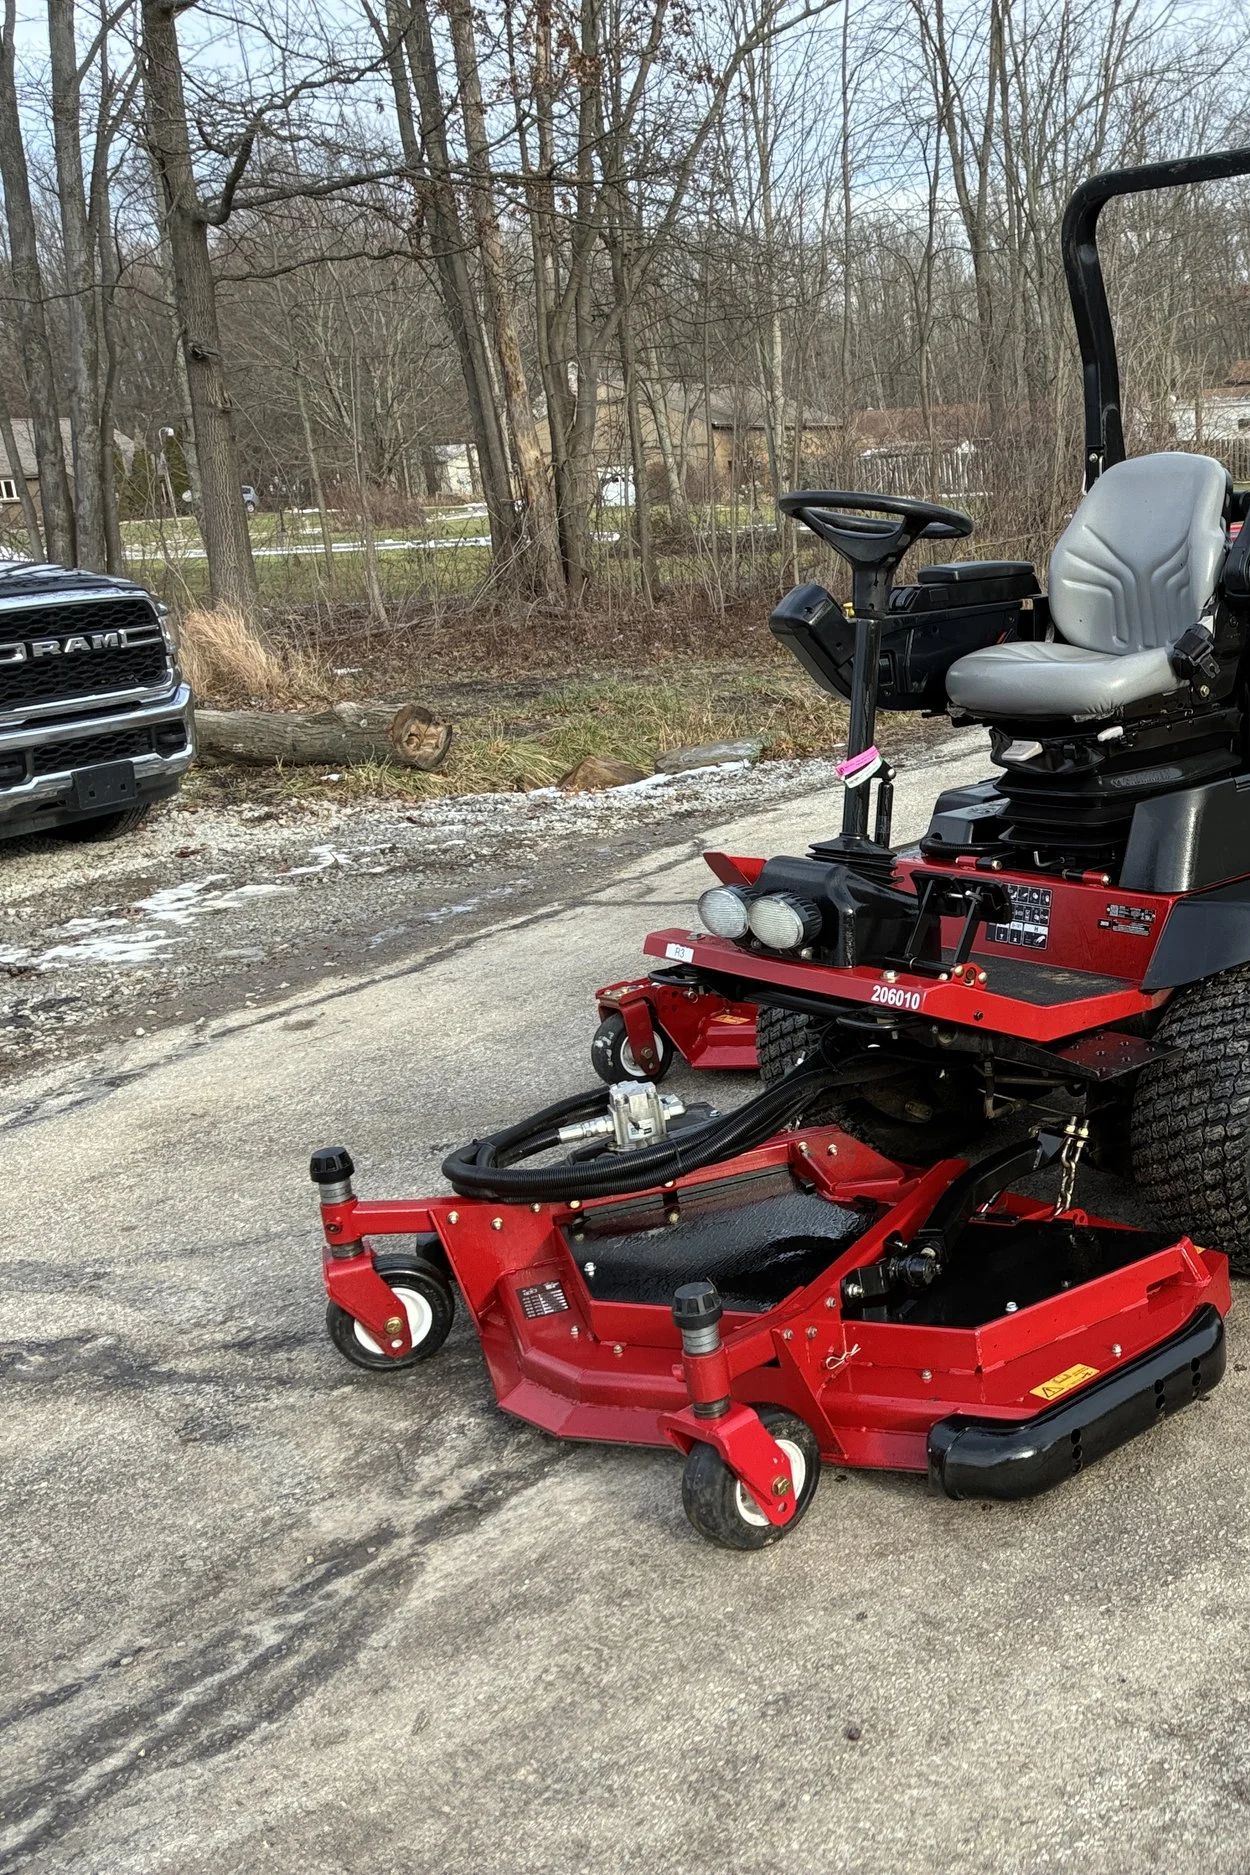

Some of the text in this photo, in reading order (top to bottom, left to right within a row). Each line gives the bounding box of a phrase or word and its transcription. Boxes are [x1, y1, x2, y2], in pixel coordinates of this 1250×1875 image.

[32, 633, 118, 657] RAM
[674, 947, 685, 958] R3
[871, 985, 920, 1010] 206010
